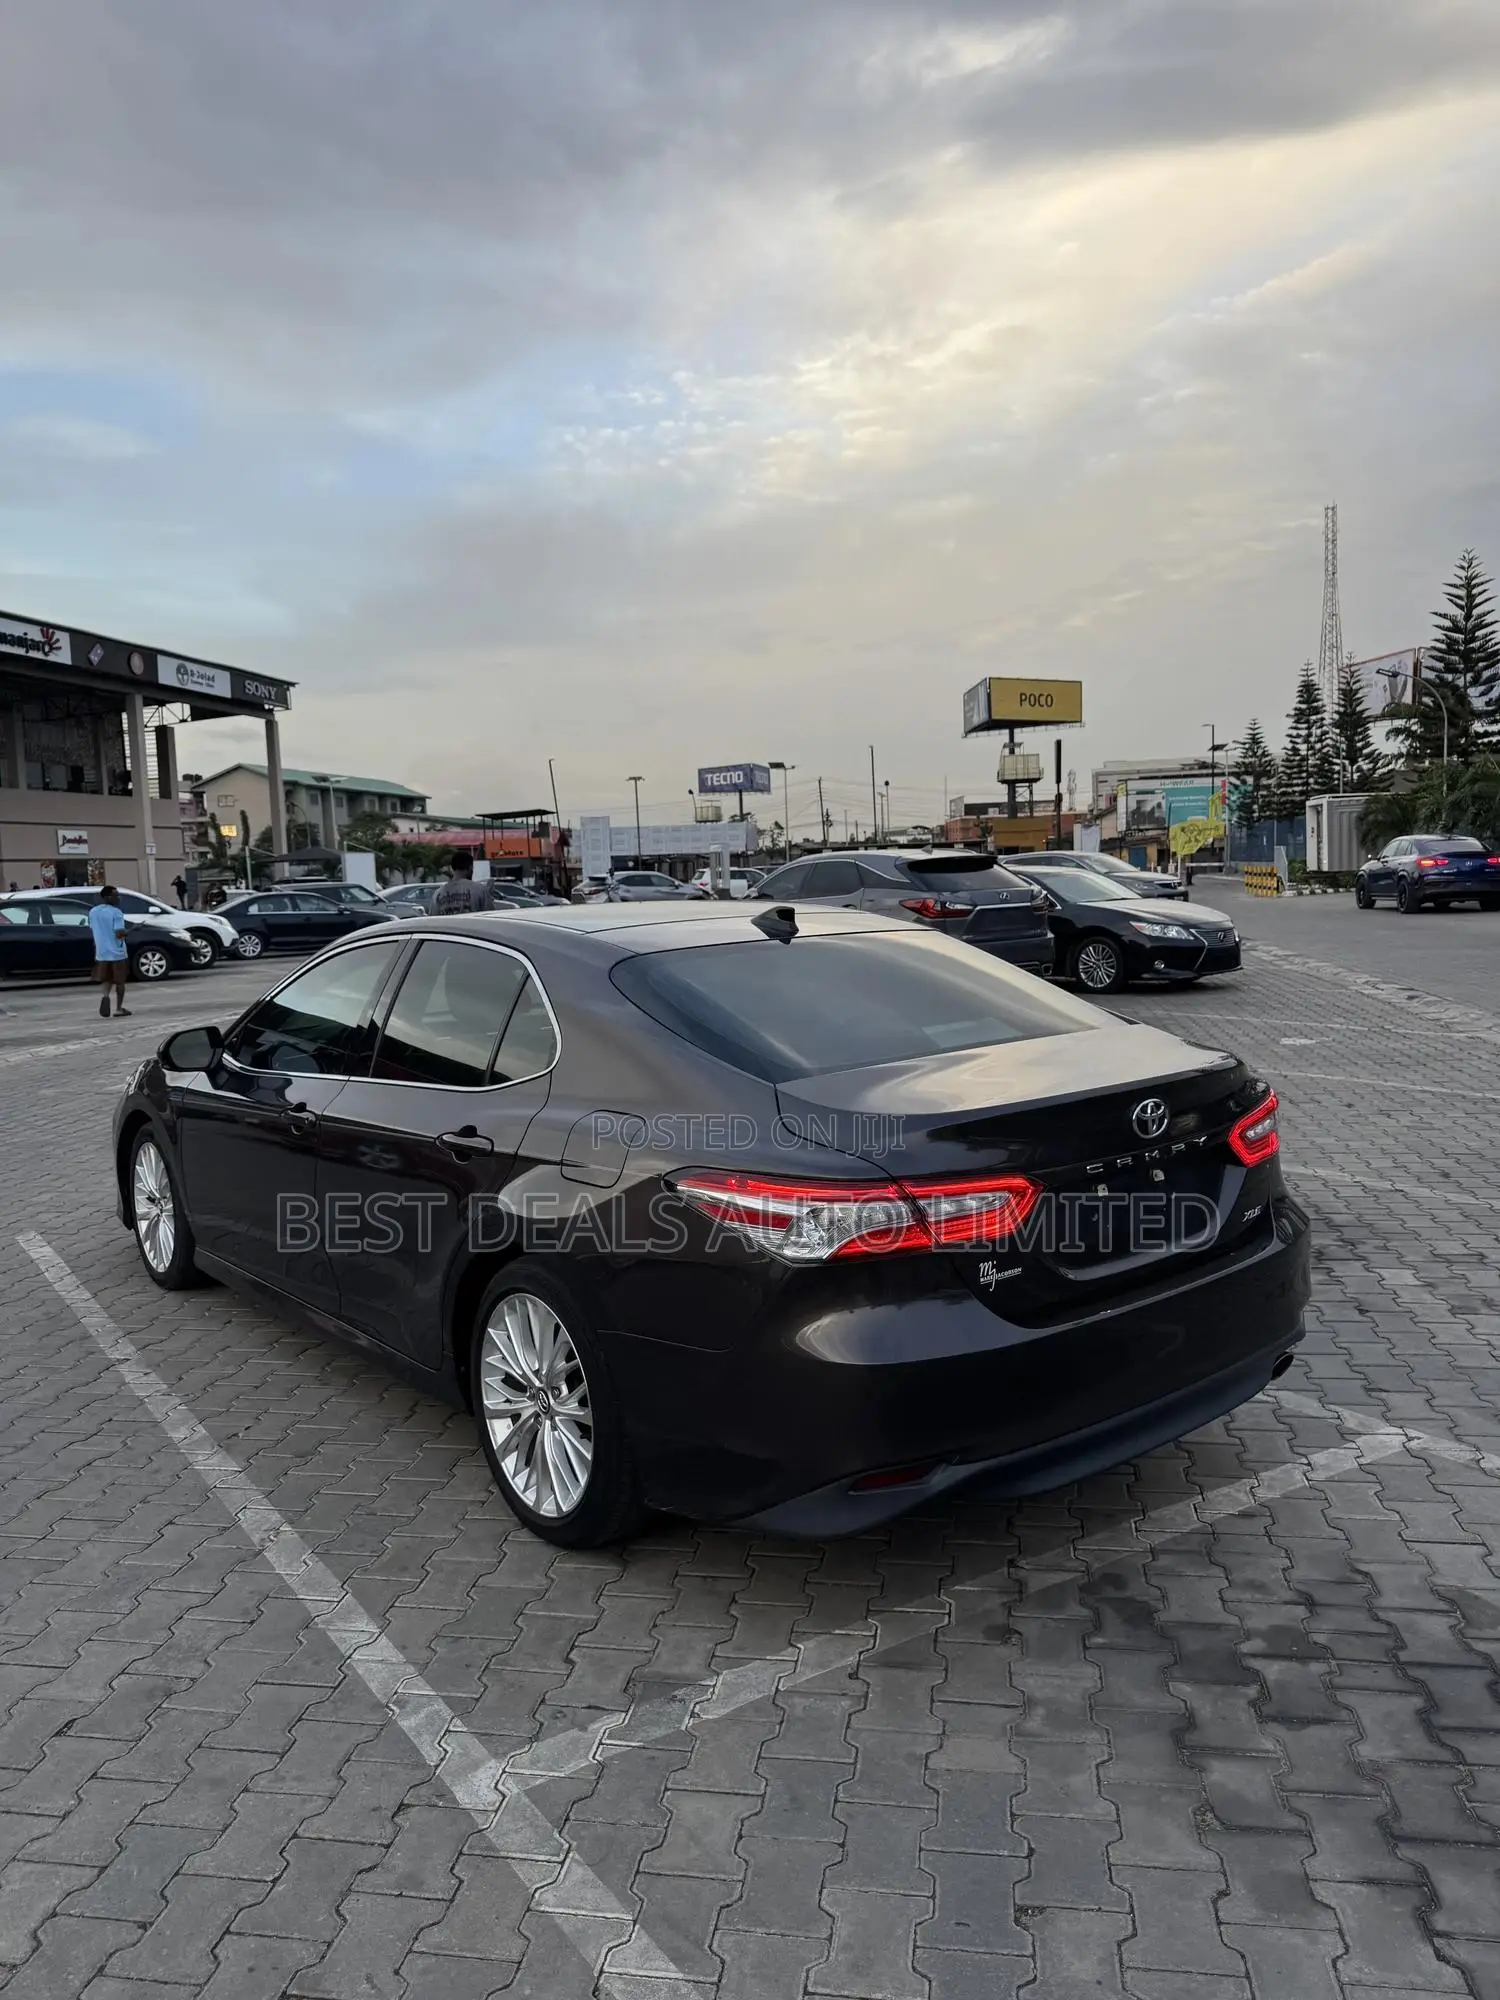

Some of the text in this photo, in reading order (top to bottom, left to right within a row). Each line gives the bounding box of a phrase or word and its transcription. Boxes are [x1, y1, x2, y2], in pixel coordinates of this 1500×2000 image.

[244, 680, 277, 699] SONY
[1019, 692, 1054, 708] POCO
[705, 771, 744, 786] TECNO
[1086, 1135, 1208, 1174] CAMRY
